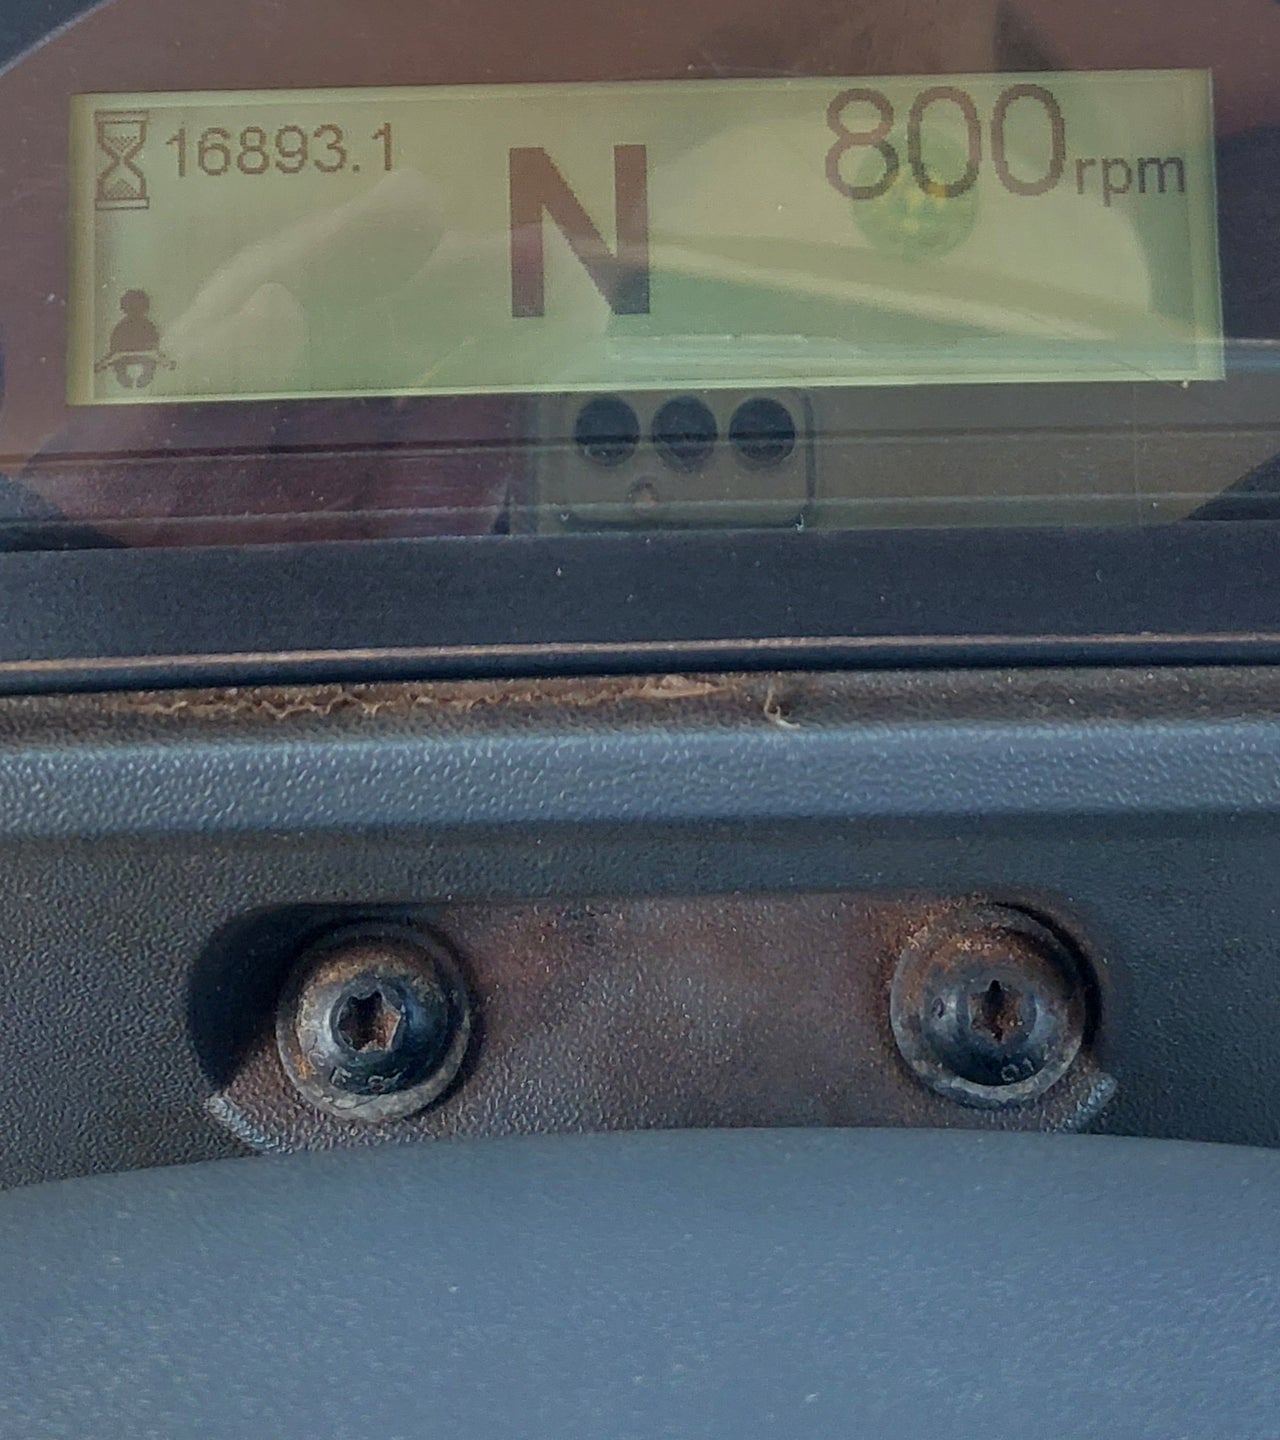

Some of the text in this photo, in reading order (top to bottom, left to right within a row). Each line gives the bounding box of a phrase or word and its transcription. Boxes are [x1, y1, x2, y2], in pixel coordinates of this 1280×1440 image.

[166, 122, 396, 177] 16893.1
[826, 83, 1186, 206] 800 rpm
[509, 144, 650, 317] N
